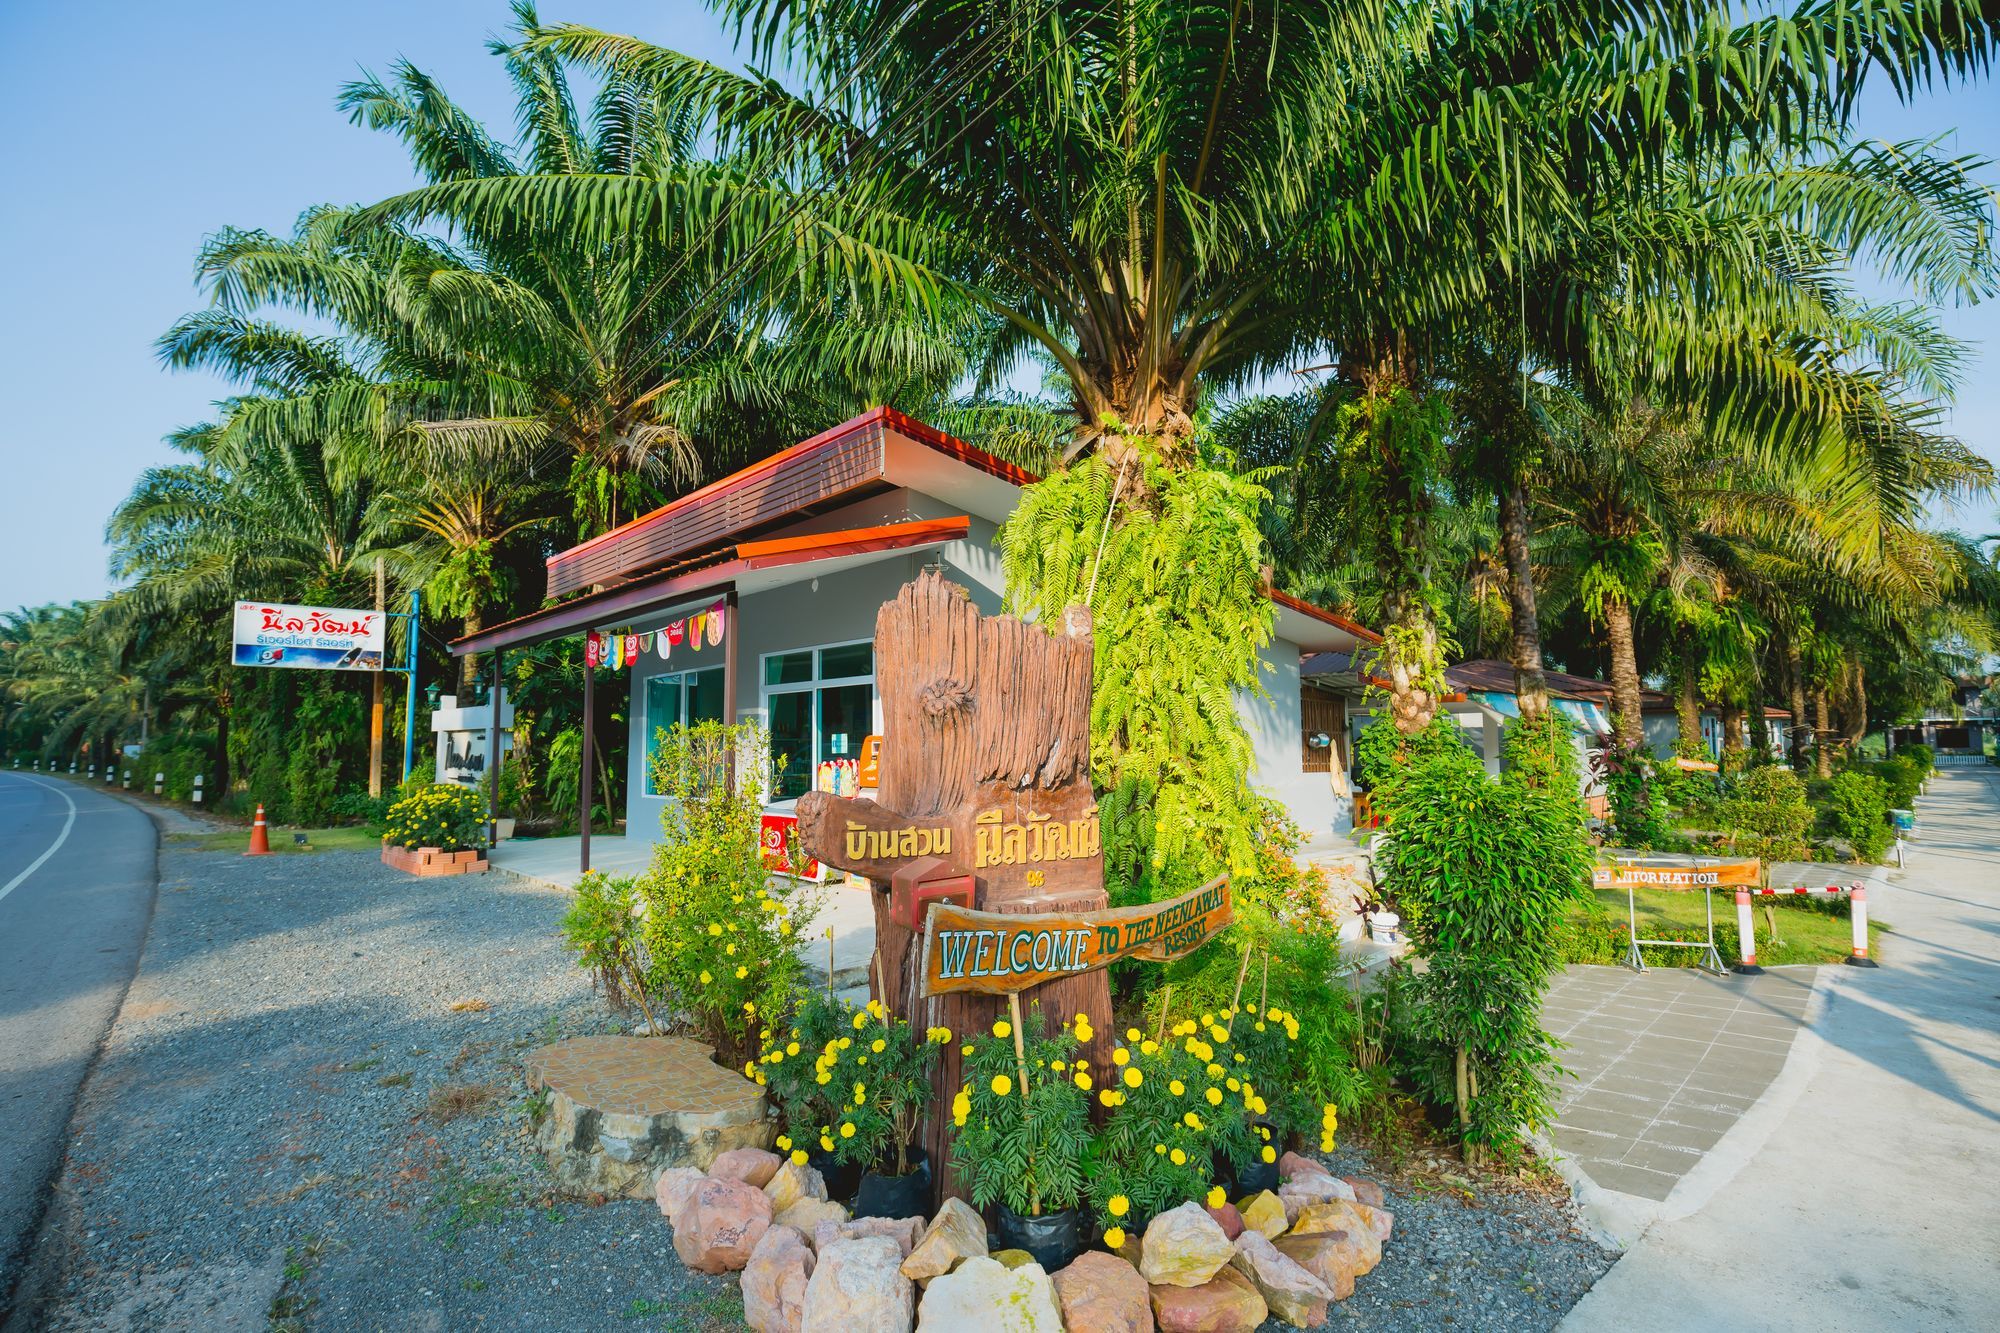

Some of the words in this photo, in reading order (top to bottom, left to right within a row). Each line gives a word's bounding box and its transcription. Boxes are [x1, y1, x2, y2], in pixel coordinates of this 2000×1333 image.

[261, 608, 378, 635] นีลวัฒน์
[846, 820, 951, 861] บ้านสวน
[975, 804, 1100, 868] นีลวัฒน์
[939, 930, 1092, 979] WELCOME
[1097, 925, 1119, 955] TO
[1125, 917, 1153, 948] THE
[1154, 884, 1225, 938] NEENLAWAT
[1164, 917, 1207, 957] RESORT
